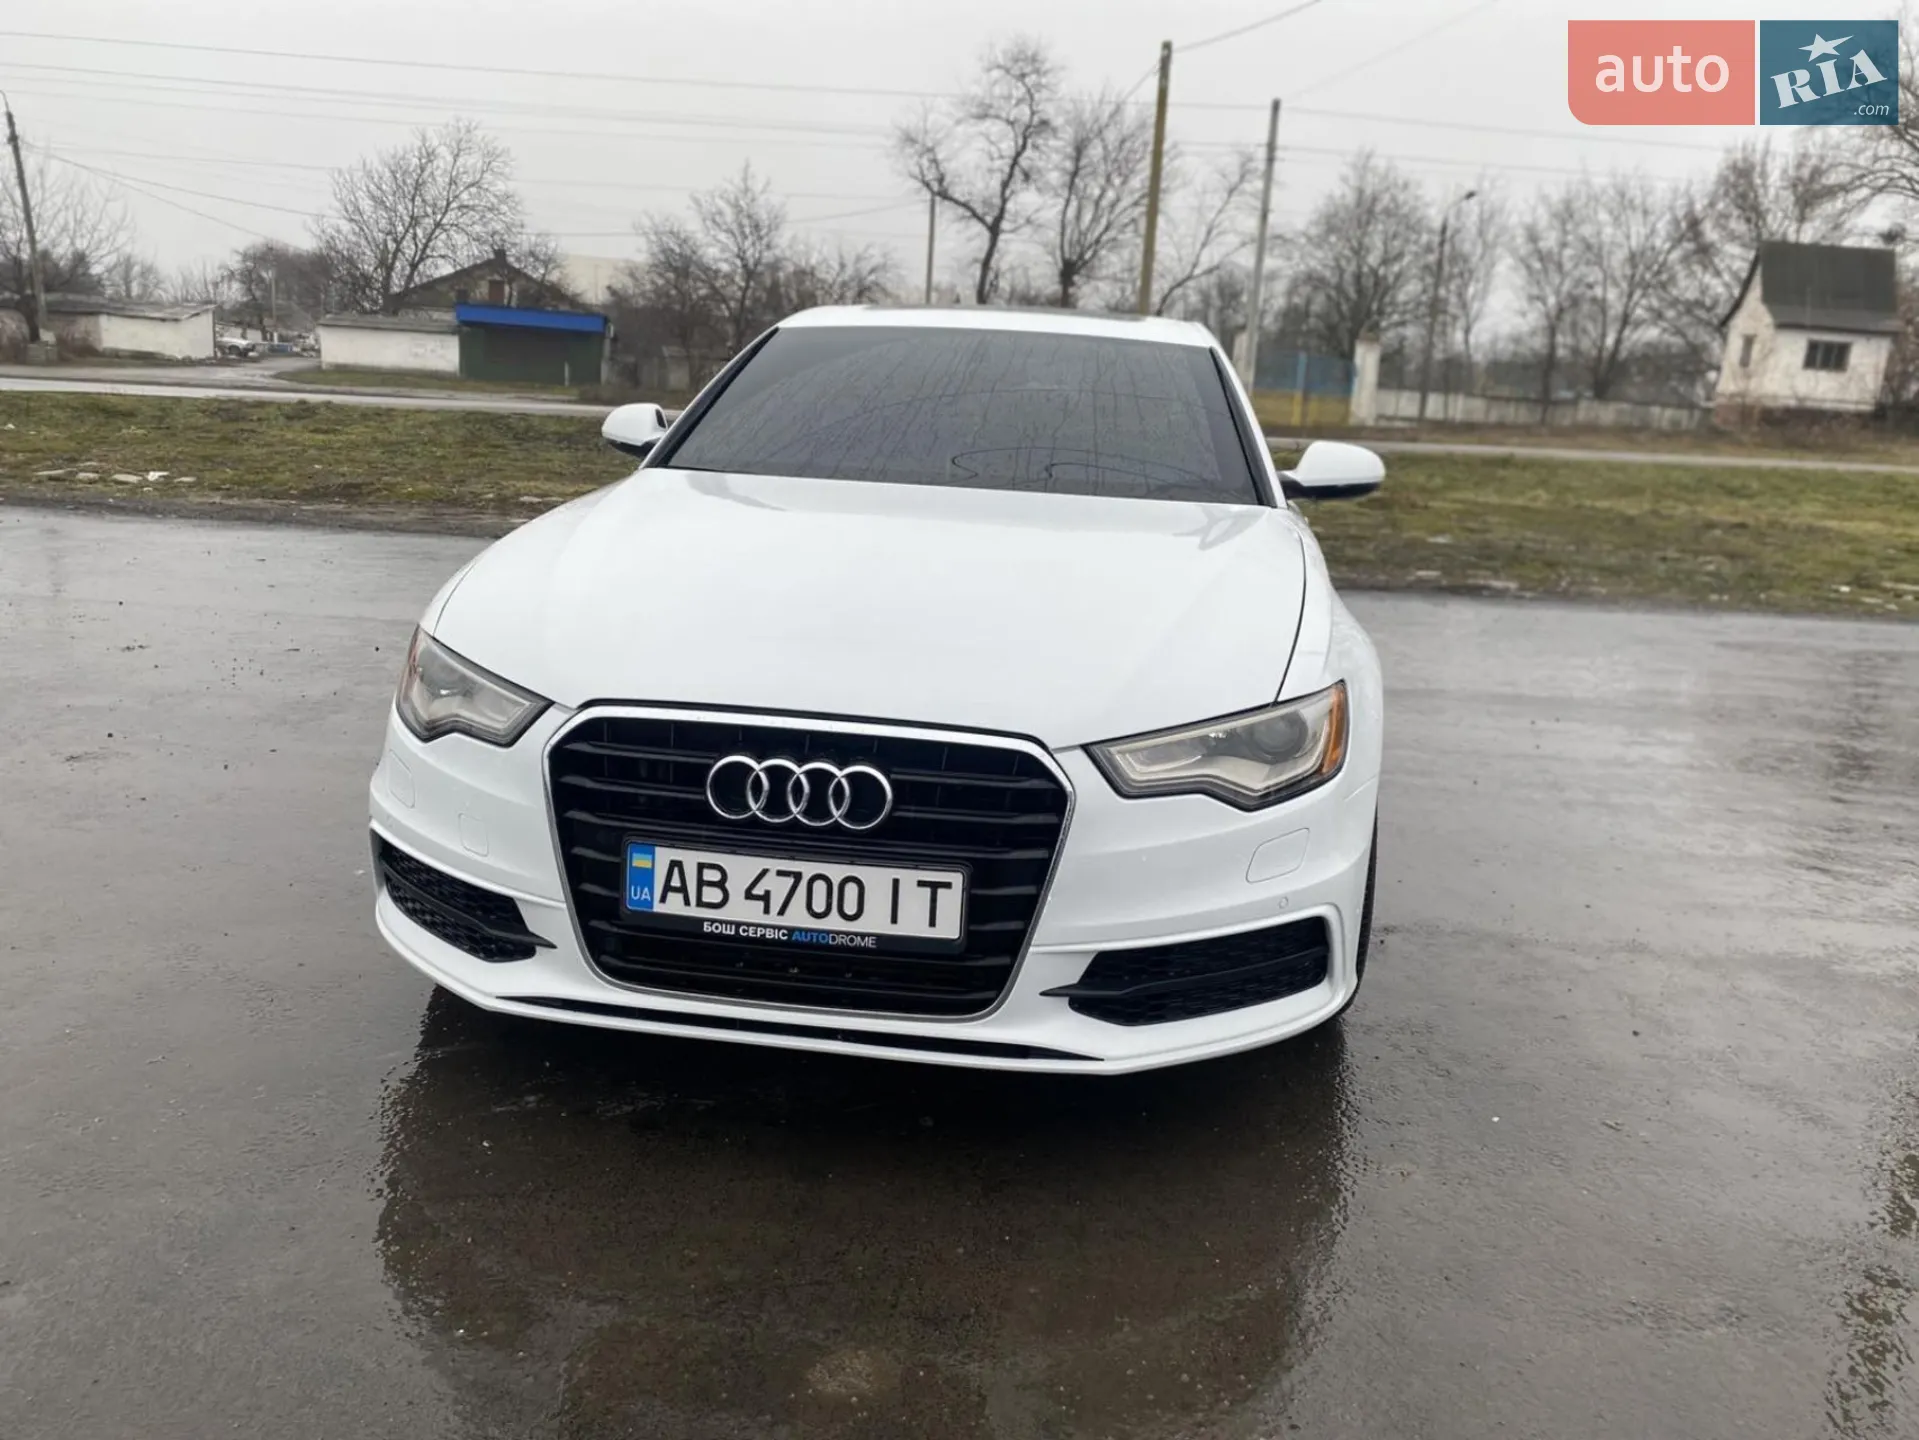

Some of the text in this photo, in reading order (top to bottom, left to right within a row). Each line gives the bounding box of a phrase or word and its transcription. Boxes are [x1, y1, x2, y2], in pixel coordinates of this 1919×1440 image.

[630, 885, 652, 902] UA
[658, 859, 730, 910] AB
[744, 867, 866, 922] 4700
[703, 921, 878, 949] БОШ СЕРВІС AUTODROME
